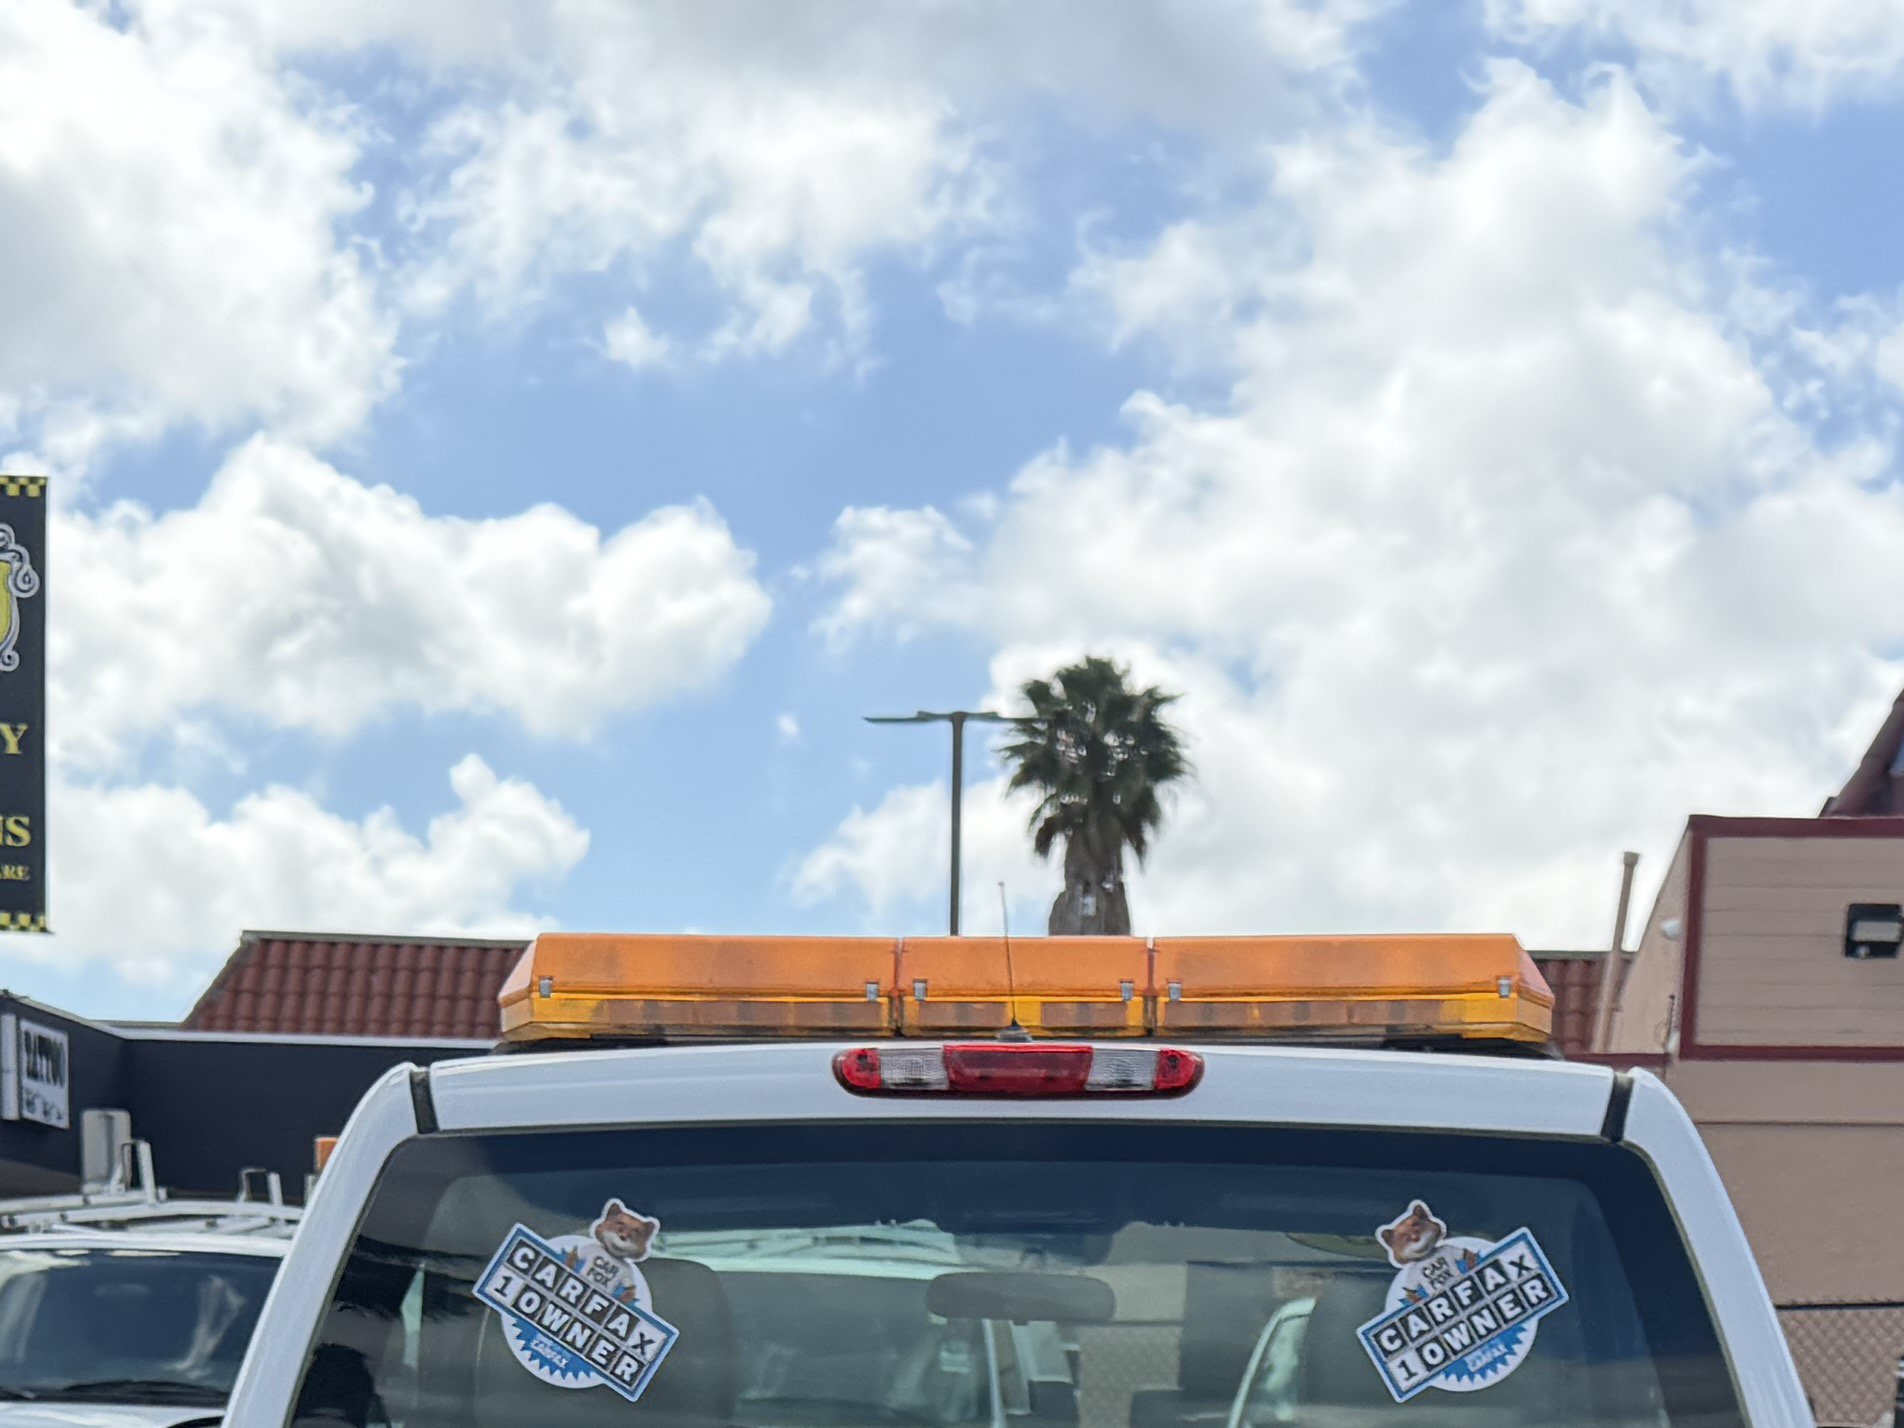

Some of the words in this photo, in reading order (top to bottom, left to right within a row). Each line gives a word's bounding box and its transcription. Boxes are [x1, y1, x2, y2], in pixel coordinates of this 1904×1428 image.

[511, 1246, 656, 1358] CARFAX
[517, 1293, 640, 1382] OWNER
[1378, 1254, 1533, 1353] CARFAX
[1421, 1277, 1550, 1366] OWNER
